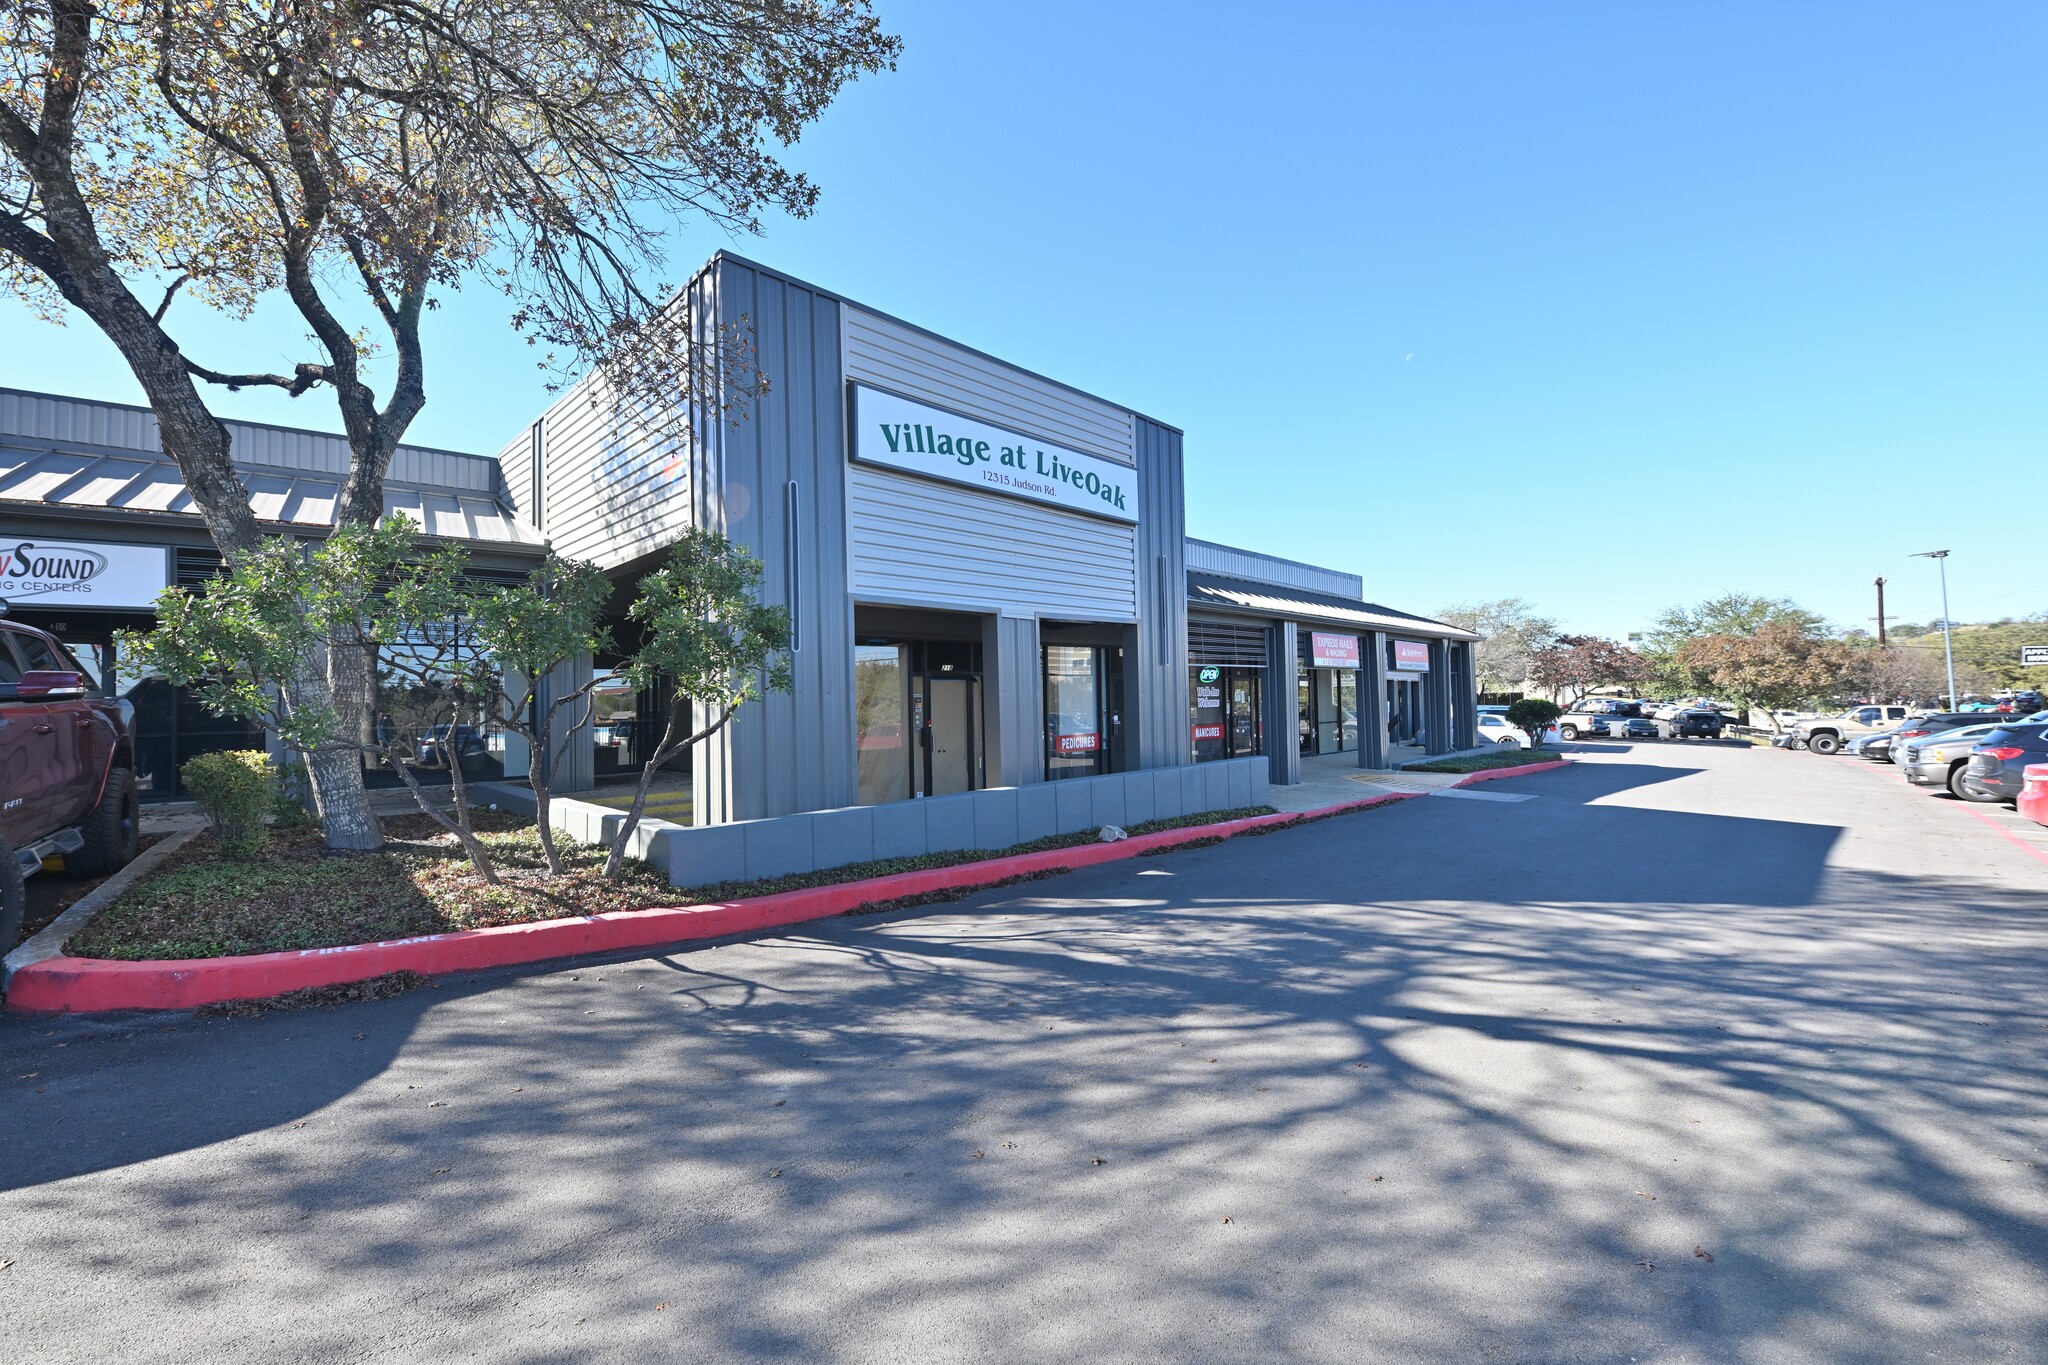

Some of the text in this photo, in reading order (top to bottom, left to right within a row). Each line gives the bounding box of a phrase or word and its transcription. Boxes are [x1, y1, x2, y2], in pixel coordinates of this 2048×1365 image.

[879, 423, 1126, 511] Village at LiveOak
[982, 470, 1057, 497] 12315 Judson Rd.
[22, 582, 92, 593] CENTERS
[1317, 636, 1353, 650] EXPRESS NAILS
[1330, 649, 1347, 658] WAXING
[1201, 669, 1217, 680] OPEN
[1197, 697, 1219, 708] Welcome
[1195, 727, 1219, 738] MANICURES
[1061, 736, 1095, 749] PEDICURES
[300, 934, 446, 957] FIRE LANE
